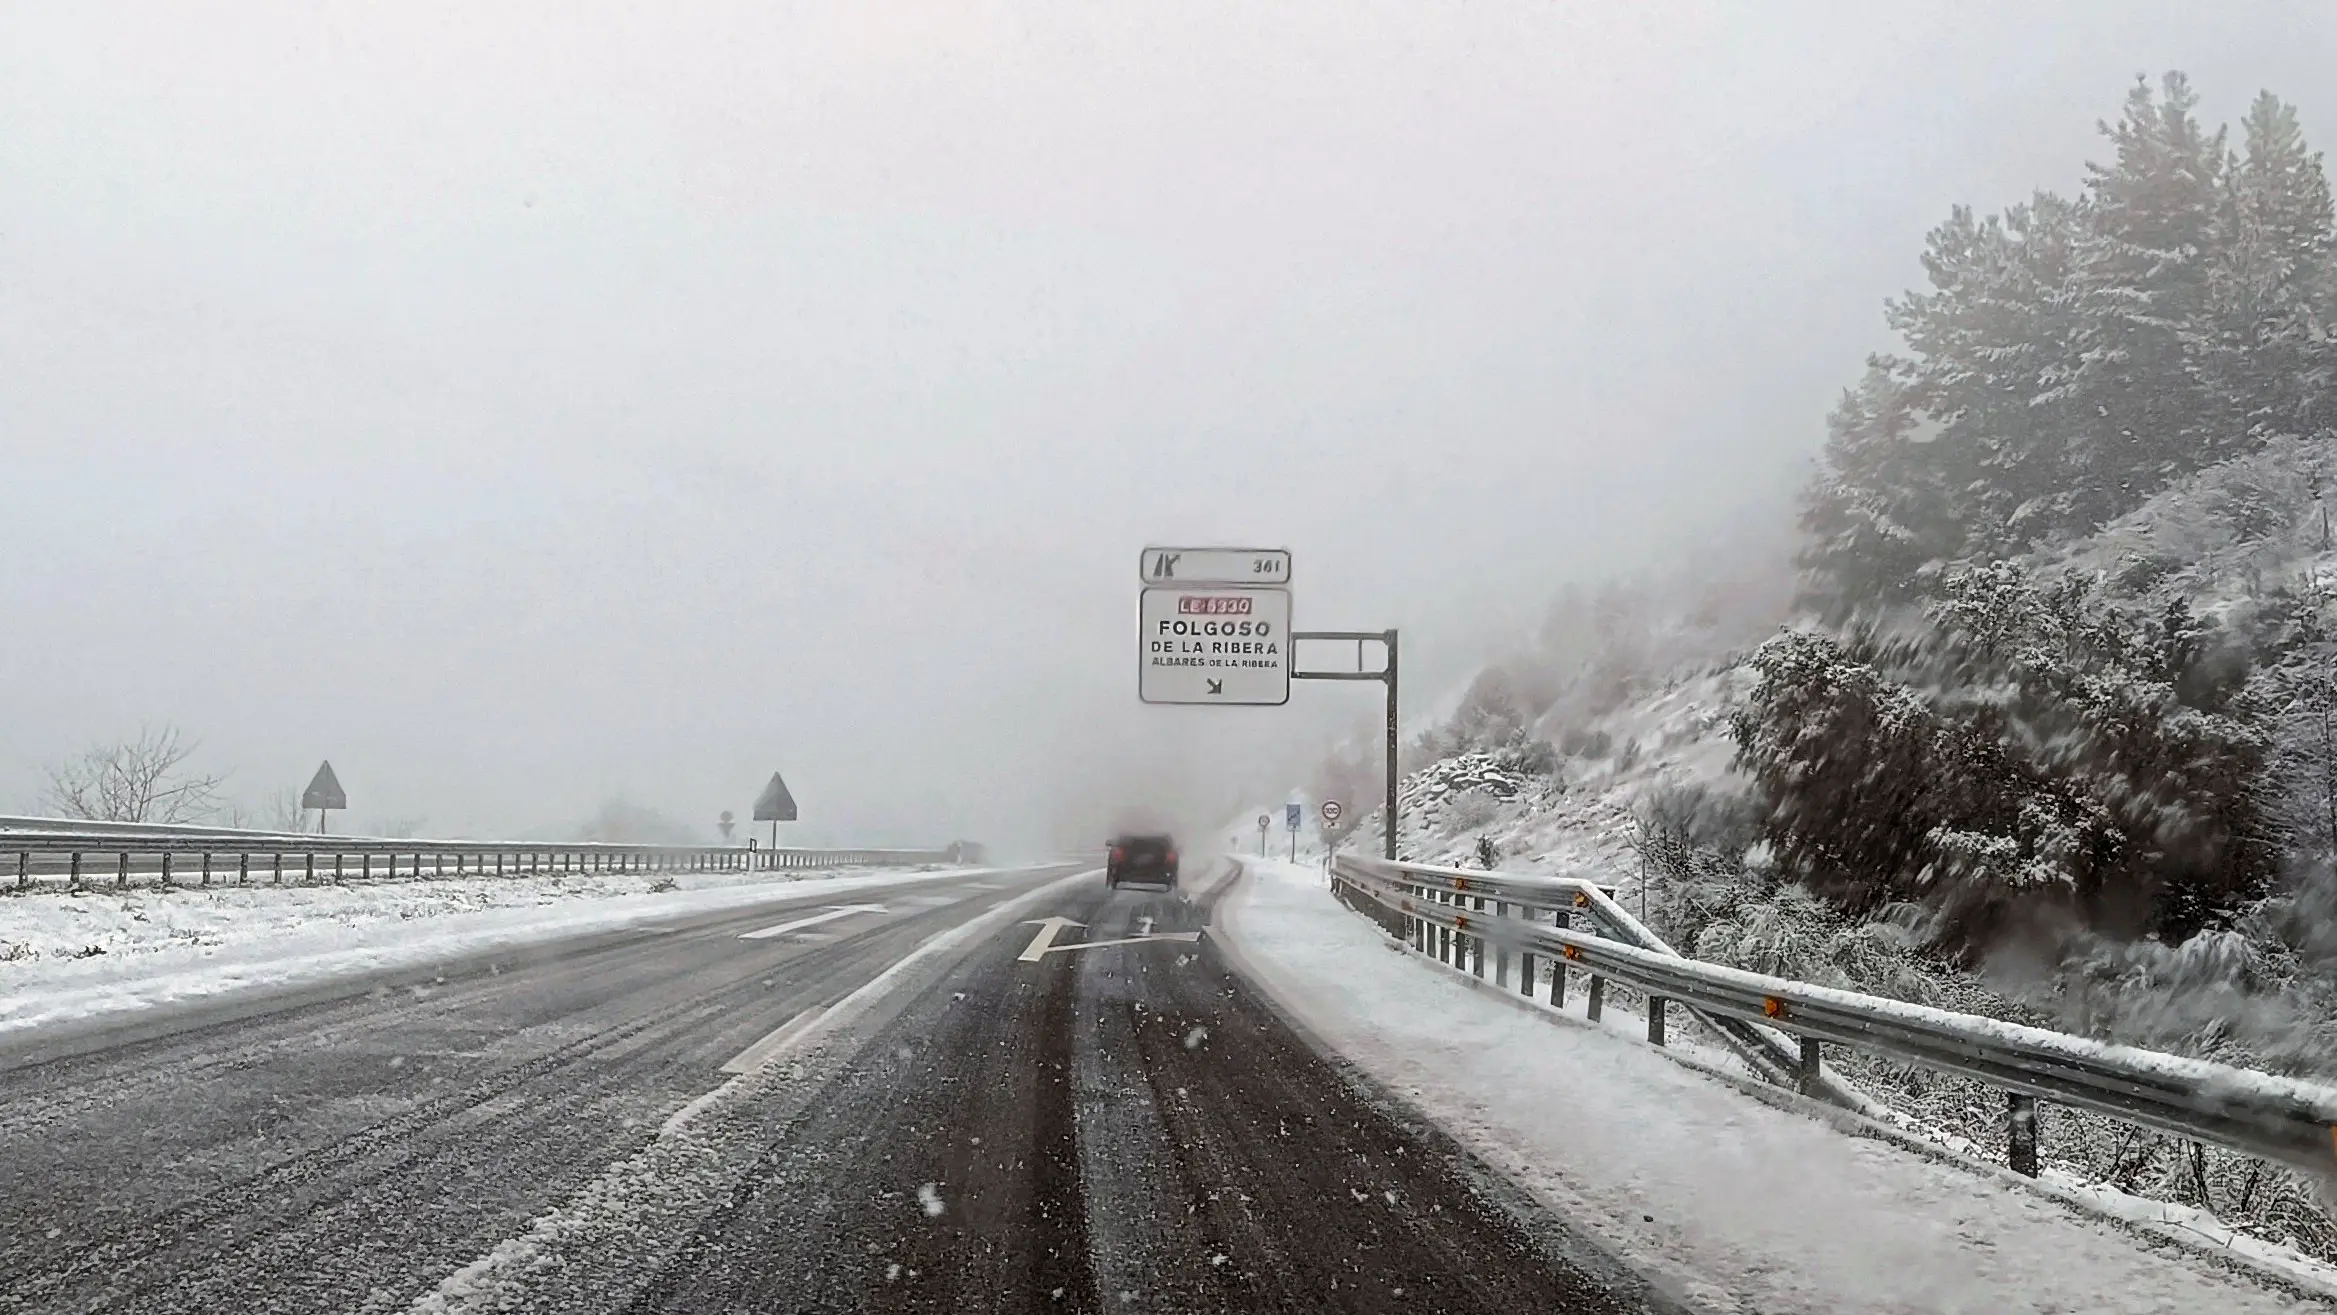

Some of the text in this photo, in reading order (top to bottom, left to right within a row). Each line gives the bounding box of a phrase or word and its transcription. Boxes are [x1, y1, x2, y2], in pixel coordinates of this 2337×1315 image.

[1159, 621, 1270, 636] FOLGOSO
[1151, 641, 1278, 655] DE LA RIBERA
[1152, 657, 1205, 667] ALBARES
[1209, 659, 1222, 667] DE
[1241, 660, 1278, 668] RIBERA
